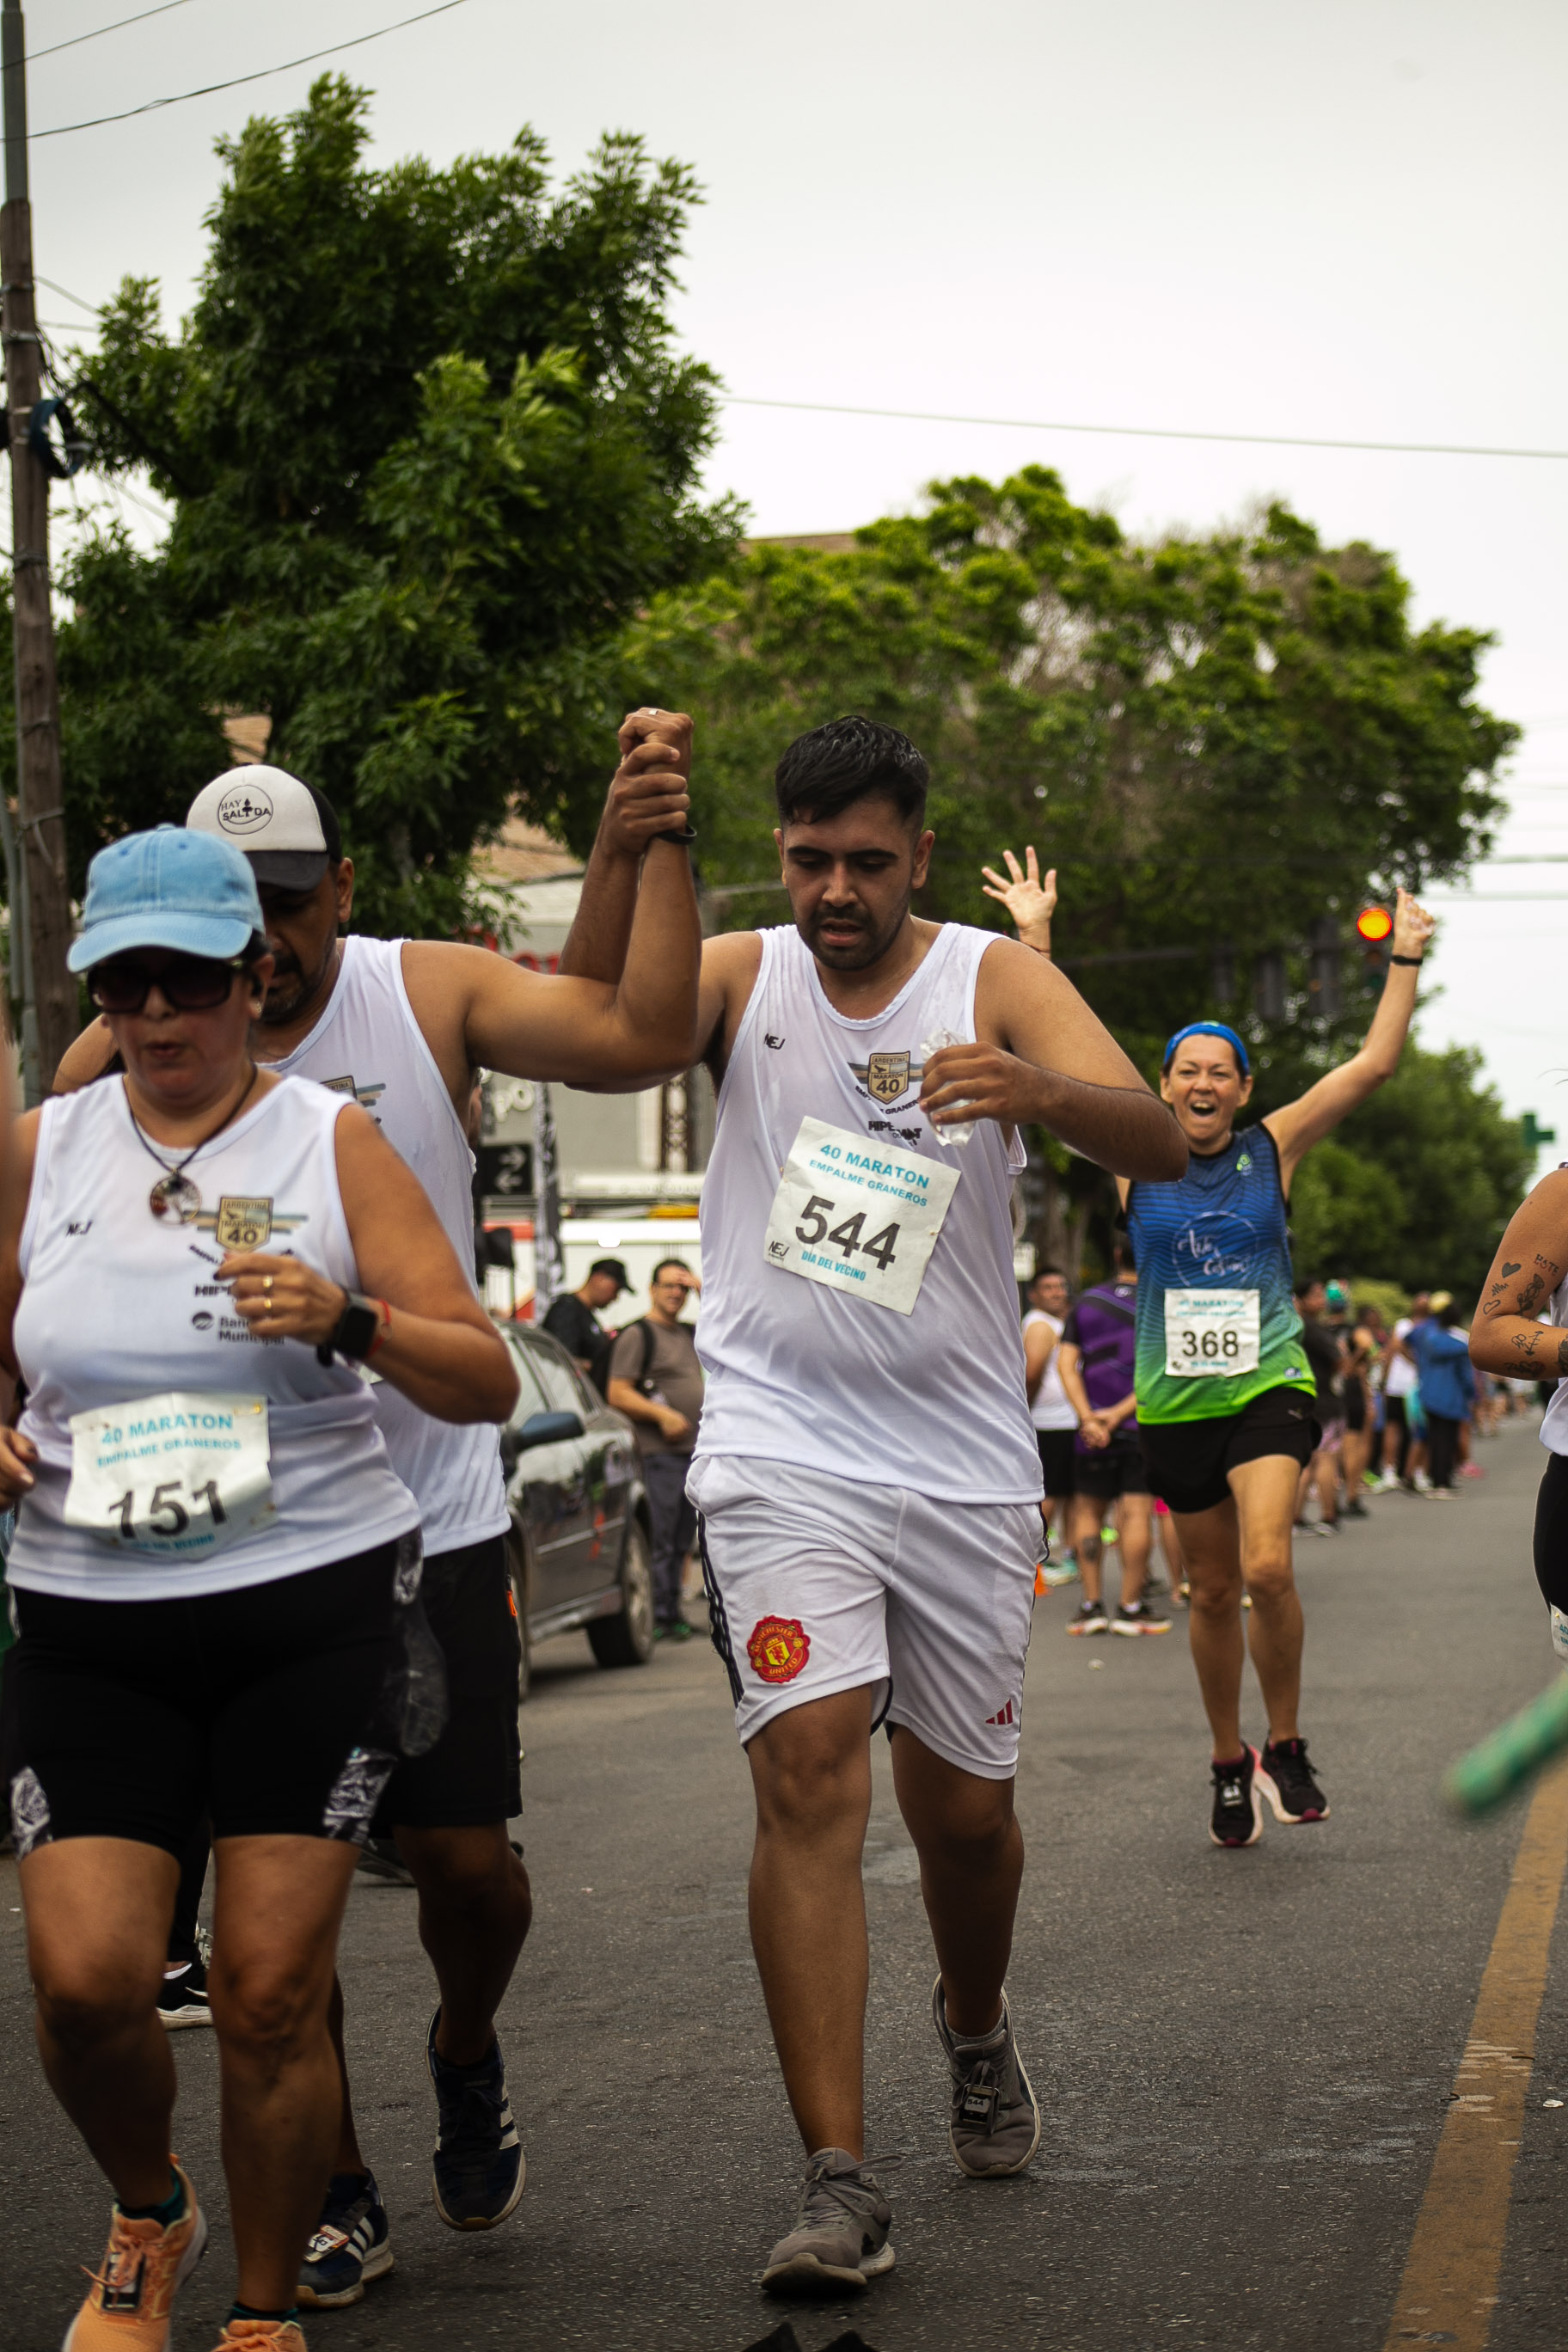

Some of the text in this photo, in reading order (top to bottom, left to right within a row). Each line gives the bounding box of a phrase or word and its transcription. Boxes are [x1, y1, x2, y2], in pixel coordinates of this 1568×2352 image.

[220, 799, 242, 812] HAY
[876, 1079, 900, 1093] 40
[885, 1099, 920, 1115] GRANER
[820, 1144, 929, 1189] 40 MARATON
[809, 1159, 928, 1207] EMPALME GRANEROS
[228, 1229, 257, 1244] 40
[795, 1195, 901, 1271] 544
[818, 1256, 833, 1270] DEL
[835, 1262, 867, 1281] VECINO
[1182, 1331, 1239, 1357] 368
[101, 1412, 233, 1445] 40 MARATON
[108, 1479, 229, 1540] 151
[769, 1657, 798, 1675] UNITED
